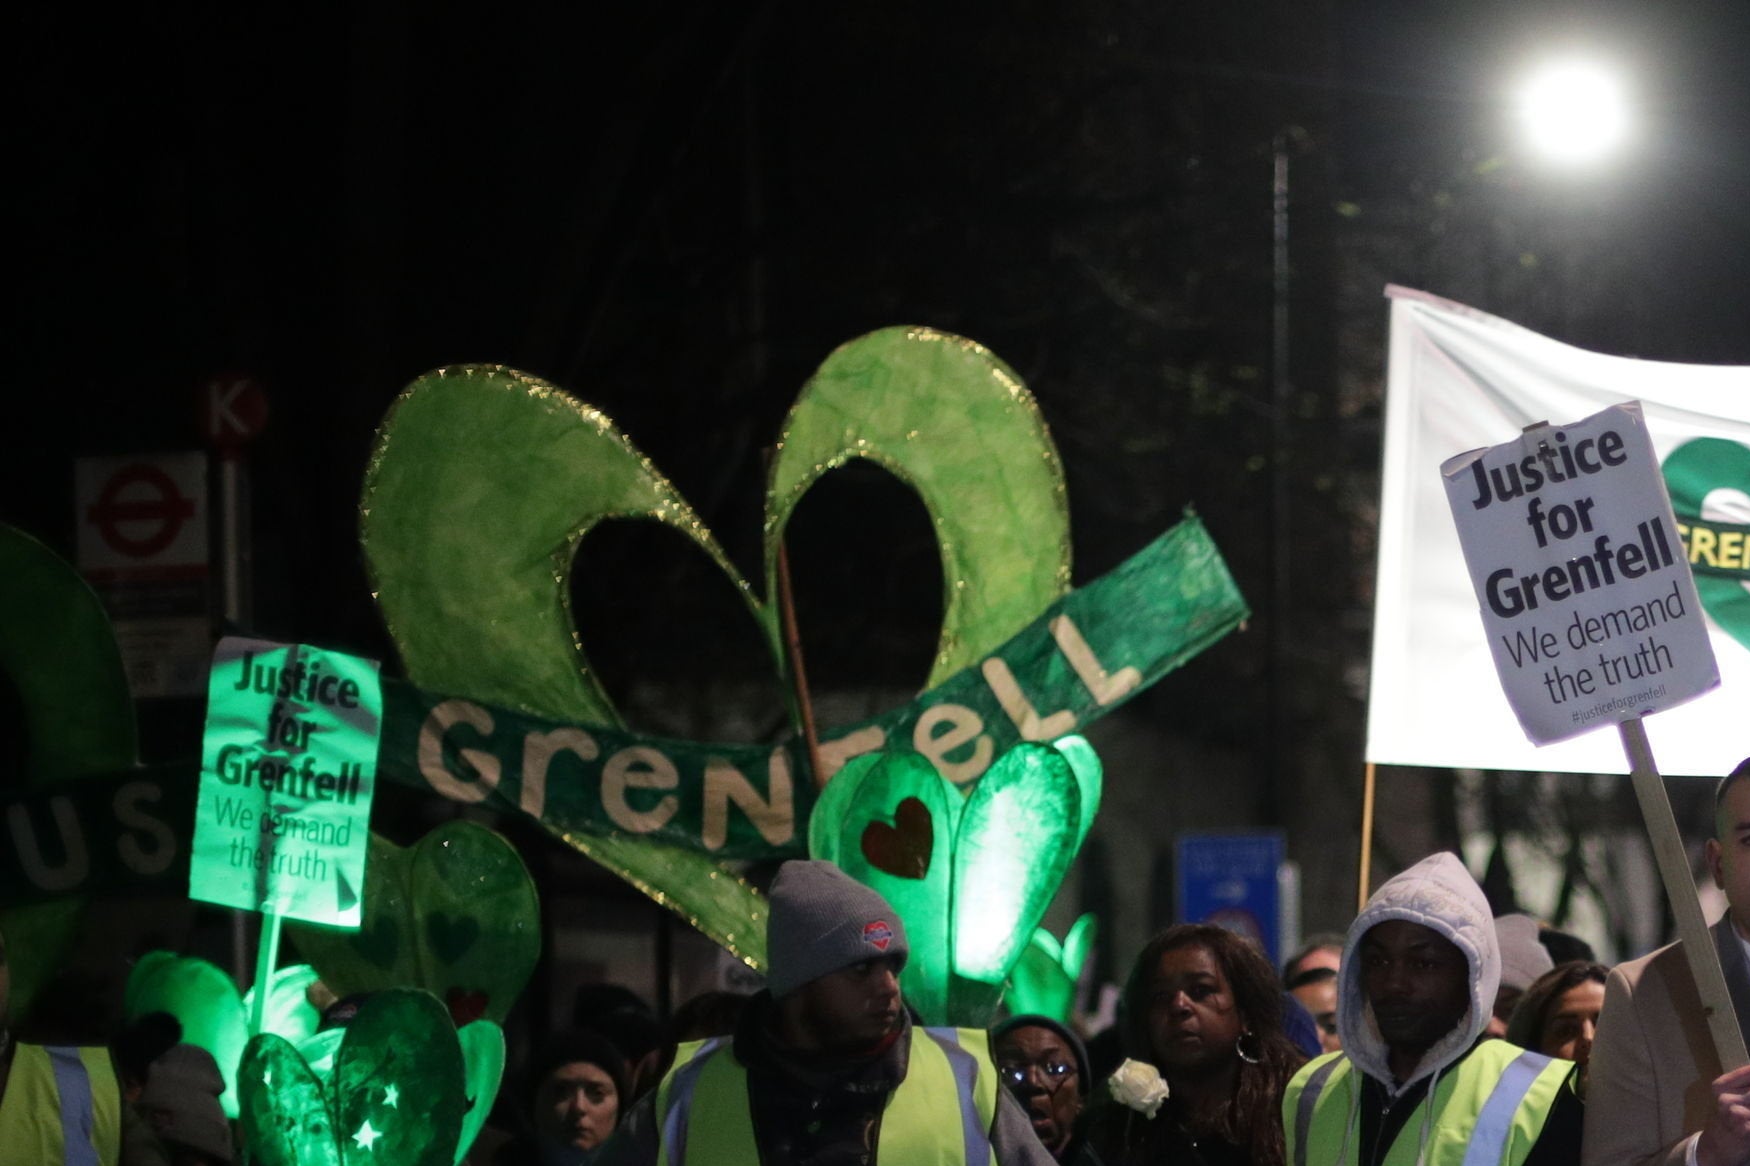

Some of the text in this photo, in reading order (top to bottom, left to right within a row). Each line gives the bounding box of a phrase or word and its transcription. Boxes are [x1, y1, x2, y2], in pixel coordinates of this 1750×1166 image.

[207, 379, 250, 448] K
[1471, 430, 1628, 510] Justice
[1527, 496, 1595, 548] for
[1485, 516, 1675, 619] Grenfell
[1502, 580, 1686, 668] We demand
[235, 651, 360, 709] Justice
[1544, 636, 1674, 704] the truth
[268, 703, 317, 750] for
[1571, 684, 1667, 725] #justiceforgrenfell
[216, 744, 361, 805] Grenfell
[214, 794, 353, 847] We demand
[230, 837, 326, 881] the truth
